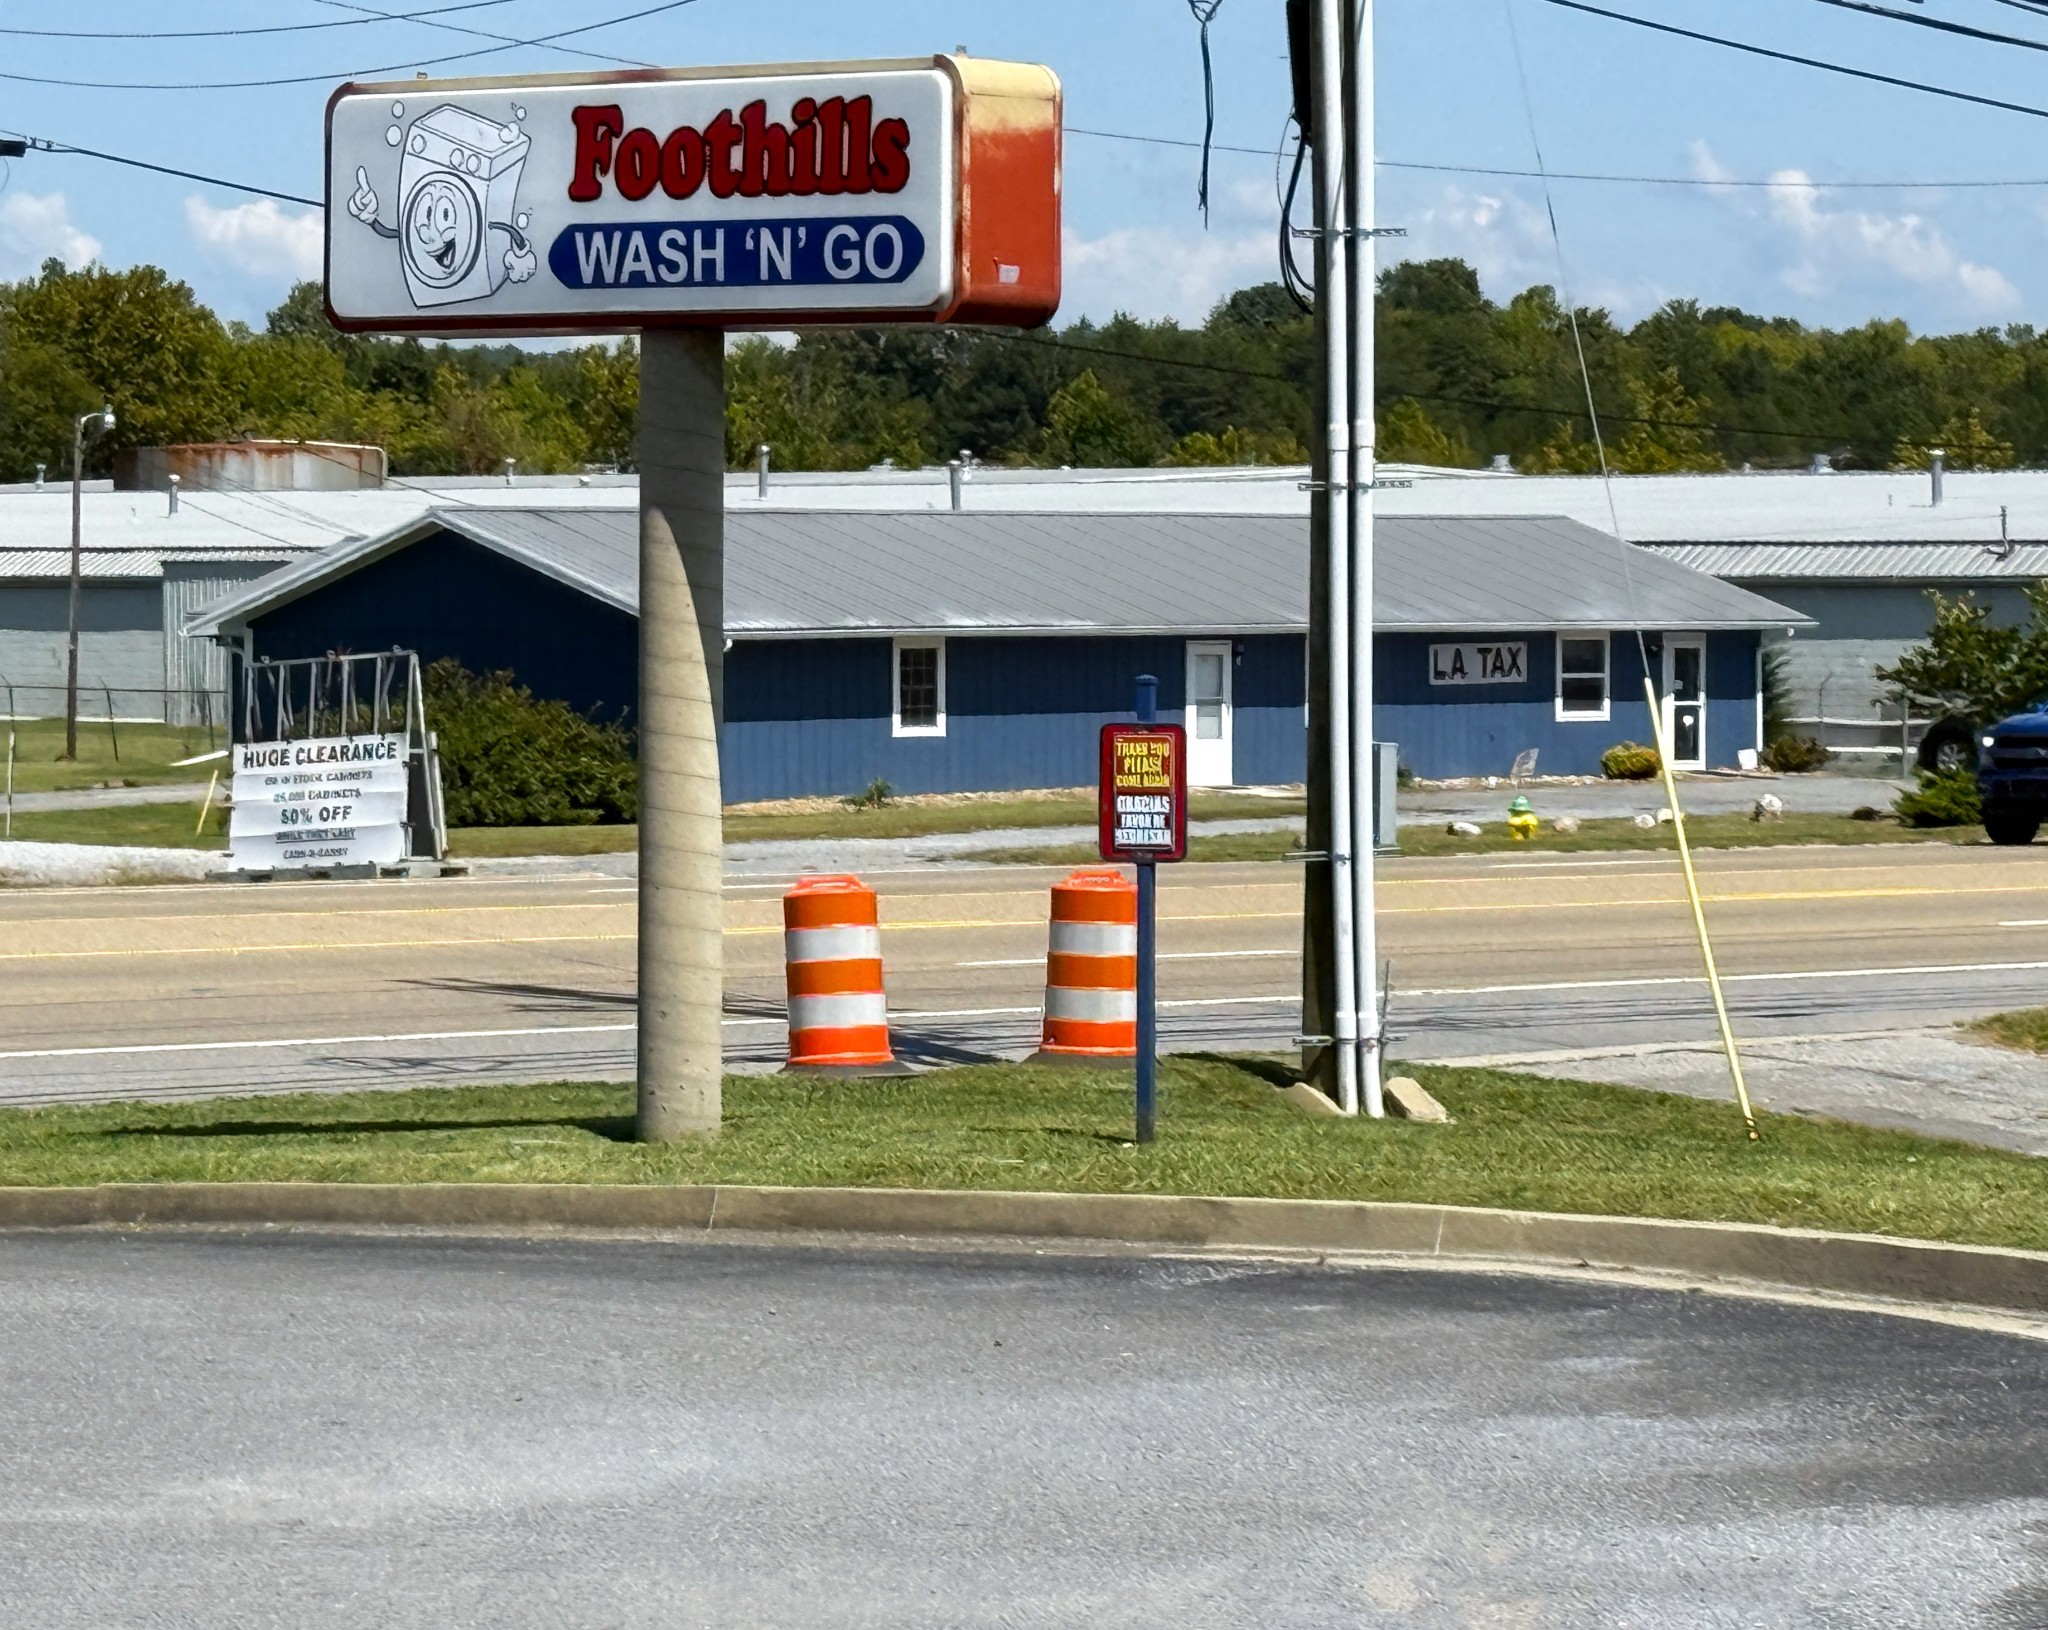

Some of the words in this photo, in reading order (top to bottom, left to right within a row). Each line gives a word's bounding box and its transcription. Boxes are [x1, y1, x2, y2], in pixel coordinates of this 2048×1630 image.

[568, 94, 911, 202] Foothills
[574, 228, 725, 284] WASH
[823, 223, 903, 280] GO
[1433, 648, 1468, 680] LA
[1477, 646, 1522, 678] TAX
[243, 748, 290, 768] HUGE
[295, 742, 397, 765] CLEARANCE
[280, 808, 313, 825] 50%
[319, 805, 352, 822] OFF
